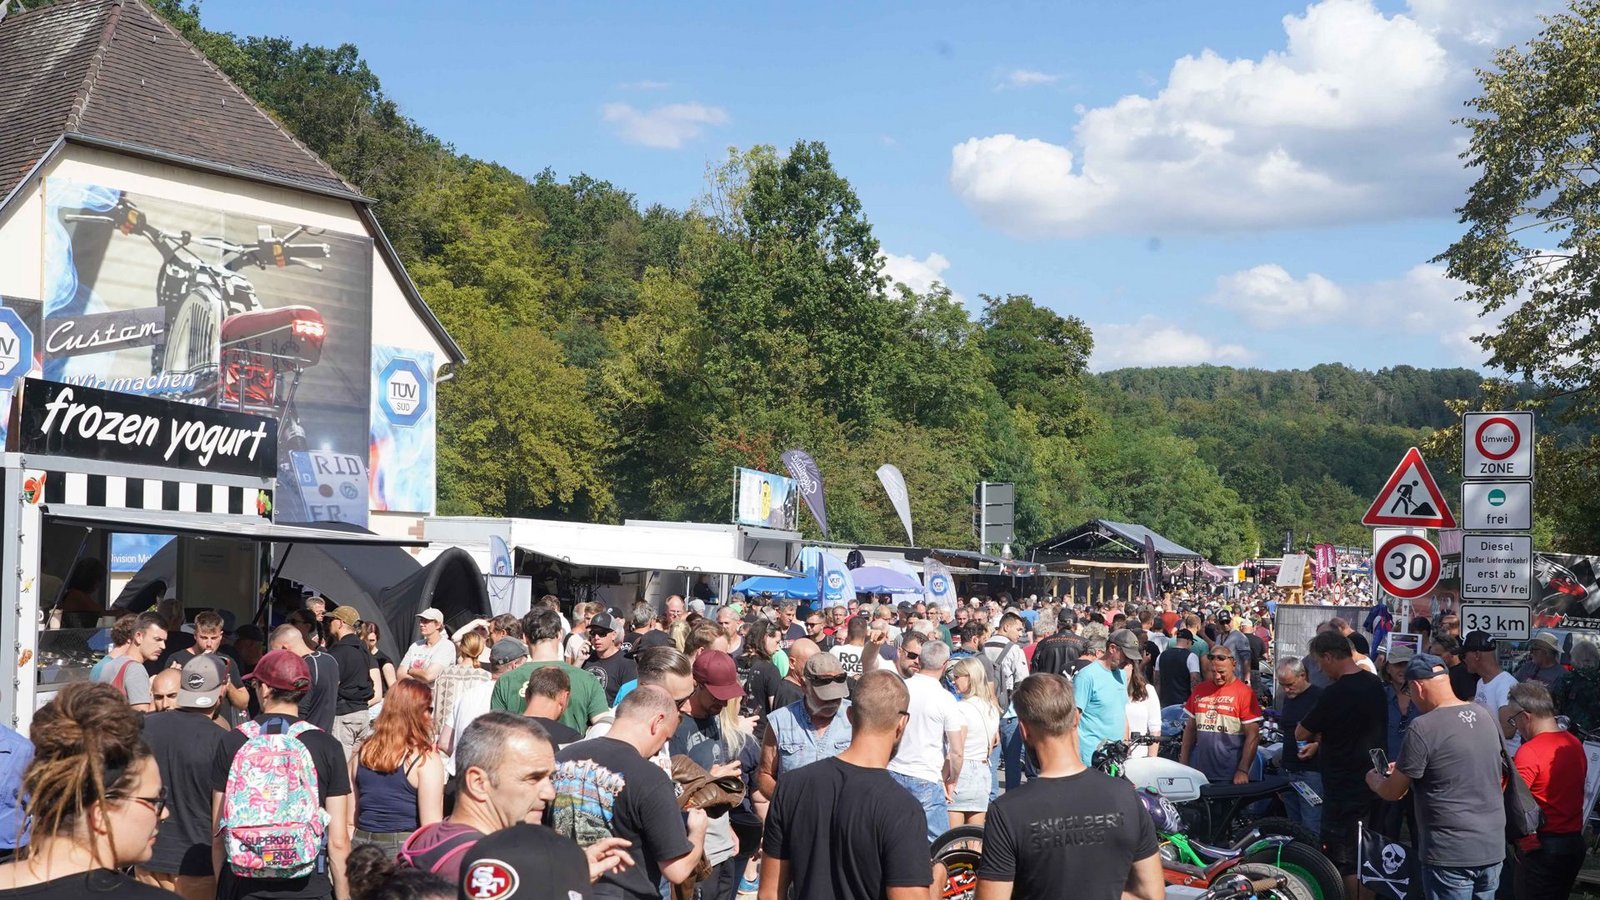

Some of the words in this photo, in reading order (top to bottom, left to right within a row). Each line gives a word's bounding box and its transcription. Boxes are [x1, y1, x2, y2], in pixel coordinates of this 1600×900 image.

[46, 320, 164, 353] Custom
[111, 371, 196, 392] machen
[390, 382, 417, 399] TÜV
[40, 386, 160, 447] frozen
[163, 418, 267, 468] yogurt
[1481, 435, 1514, 443] Umwelt
[314, 455, 361, 476] RID
[1480, 463, 1514, 473] ZONE
[1487, 514, 1508, 524] frei
[1480, 541, 1514, 551] Diesel
[111, 554, 137, 563] ivision
[1487, 556, 1529, 564] Lieferverkehr)
[1388, 552, 1427, 582] 30
[1477, 570, 1498, 578] erst
[1503, 570, 1516, 578] ab
[1465, 584, 1488, 593] Euro
[1491, 584, 1508, 593] 5/V
[1511, 585, 1528, 594] frei
[1467, 613, 1491, 631] 3,3
[1496, 615, 1525, 631] km
[245, 834, 298, 847] SUPERDRY
